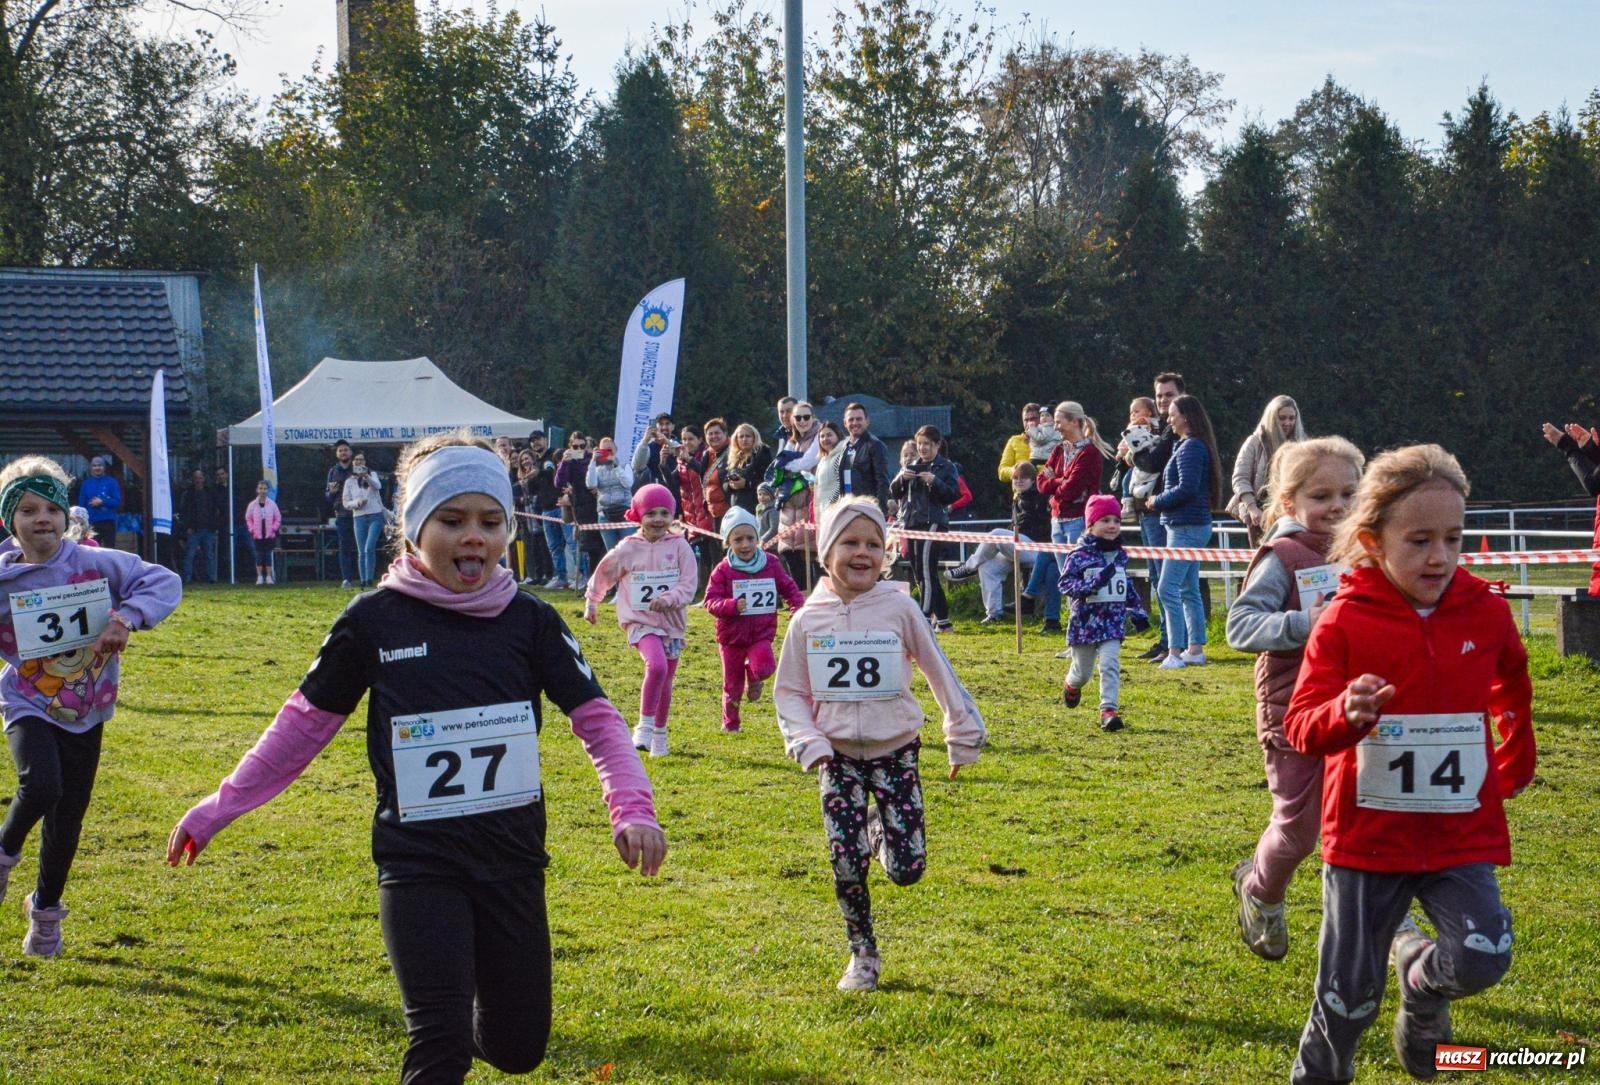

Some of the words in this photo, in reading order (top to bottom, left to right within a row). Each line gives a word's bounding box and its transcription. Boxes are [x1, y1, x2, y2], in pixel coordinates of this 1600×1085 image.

[284, 427, 353, 440] STOWARZYSZENIE
[360, 426, 394, 439] AKTYWNI
[401, 427, 416, 438] DLA
[37, 607, 89, 643] 31
[379, 643, 428, 664] hummel
[839, 638, 898, 646] www.personalbest.pl
[827, 657, 881, 688] 28
[441, 713, 529, 732] www.personalbest.pl
[425, 743, 508, 799] 27
[1388, 750, 1466, 794] 14
